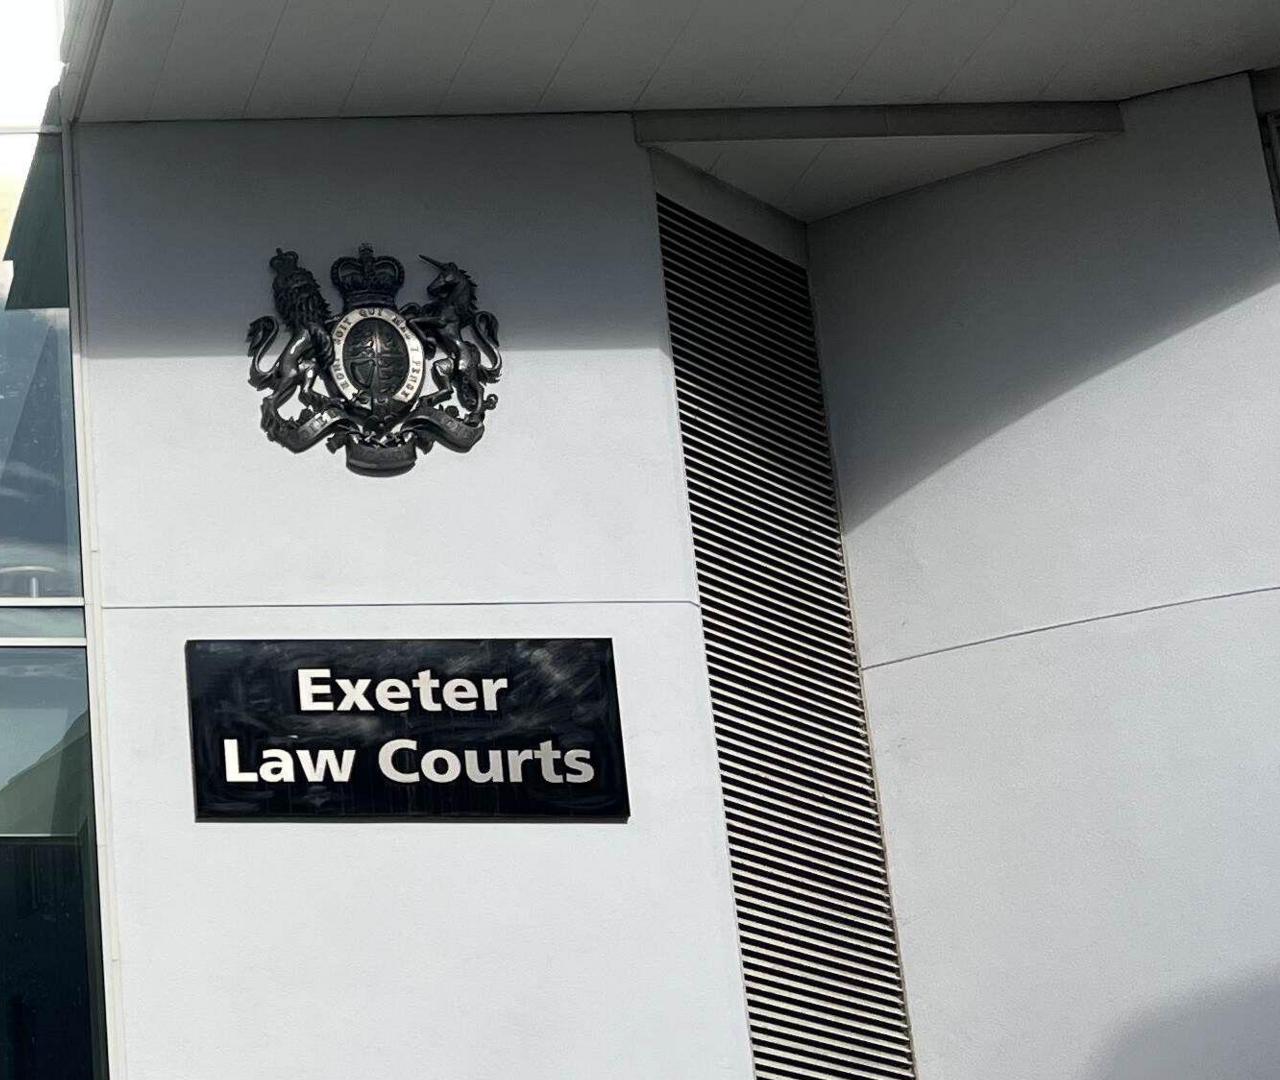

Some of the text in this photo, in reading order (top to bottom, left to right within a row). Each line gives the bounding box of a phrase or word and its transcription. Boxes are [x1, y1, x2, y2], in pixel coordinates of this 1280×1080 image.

[297, 667, 508, 712] Exeter
[222, 738, 595, 784] Law Courts
